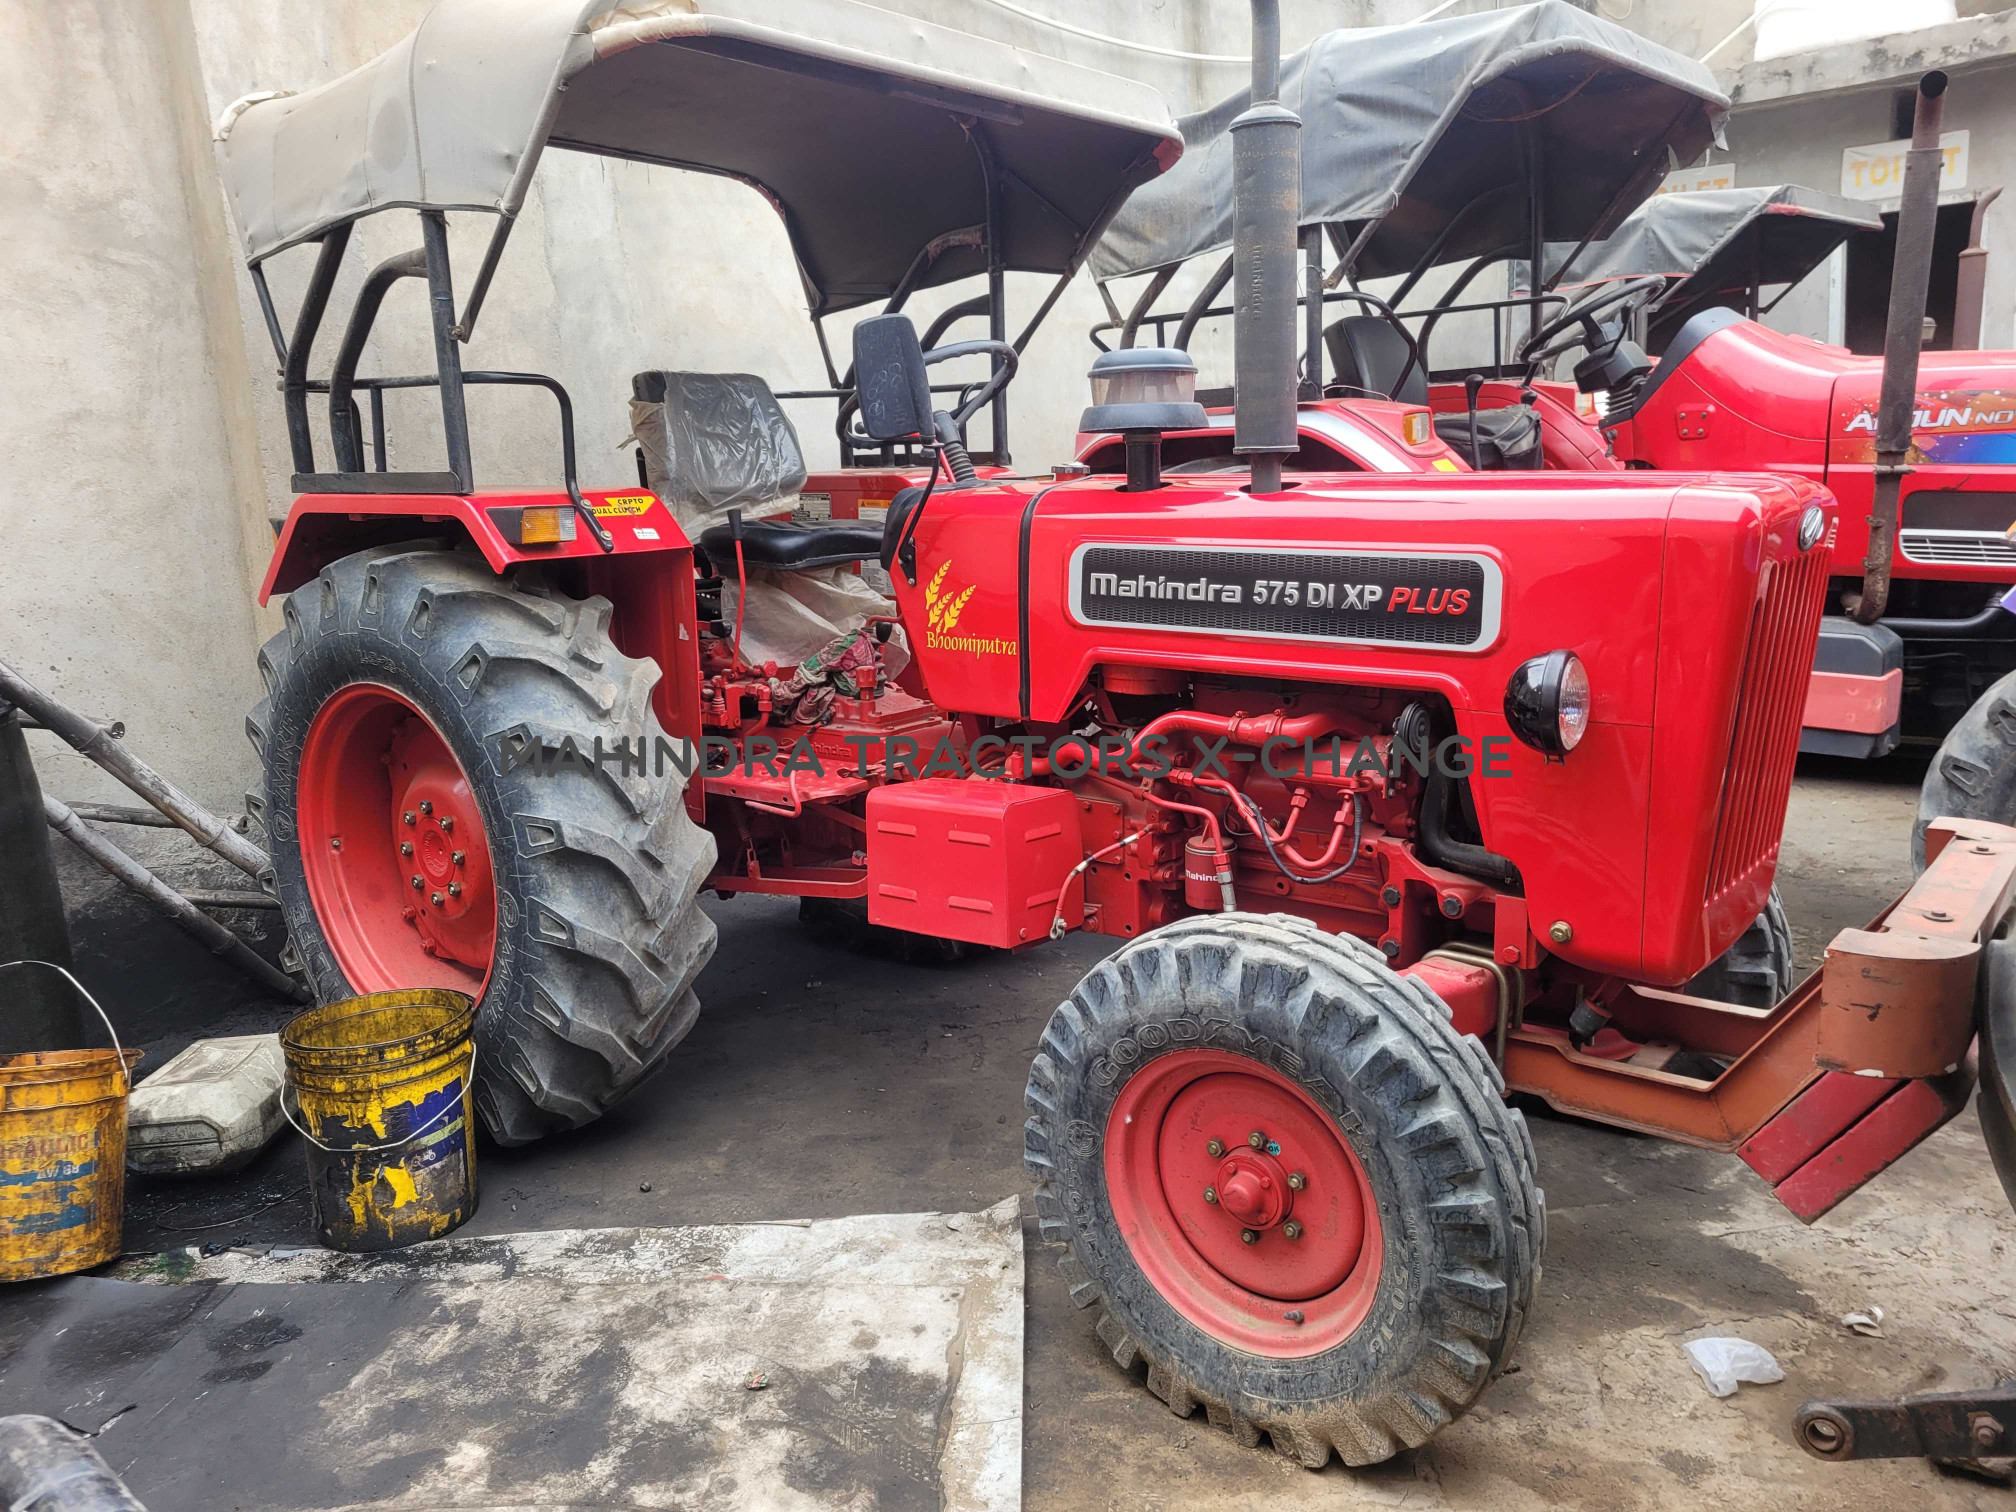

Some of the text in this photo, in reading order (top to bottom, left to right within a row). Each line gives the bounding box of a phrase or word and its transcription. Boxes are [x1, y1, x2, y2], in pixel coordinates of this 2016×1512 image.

[1850, 146, 1961, 188] TOIT
[1089, 572, 1471, 616] Mahindra 575 DI XP PLUS
[926, 631, 1018, 660] Bhoomiputra
